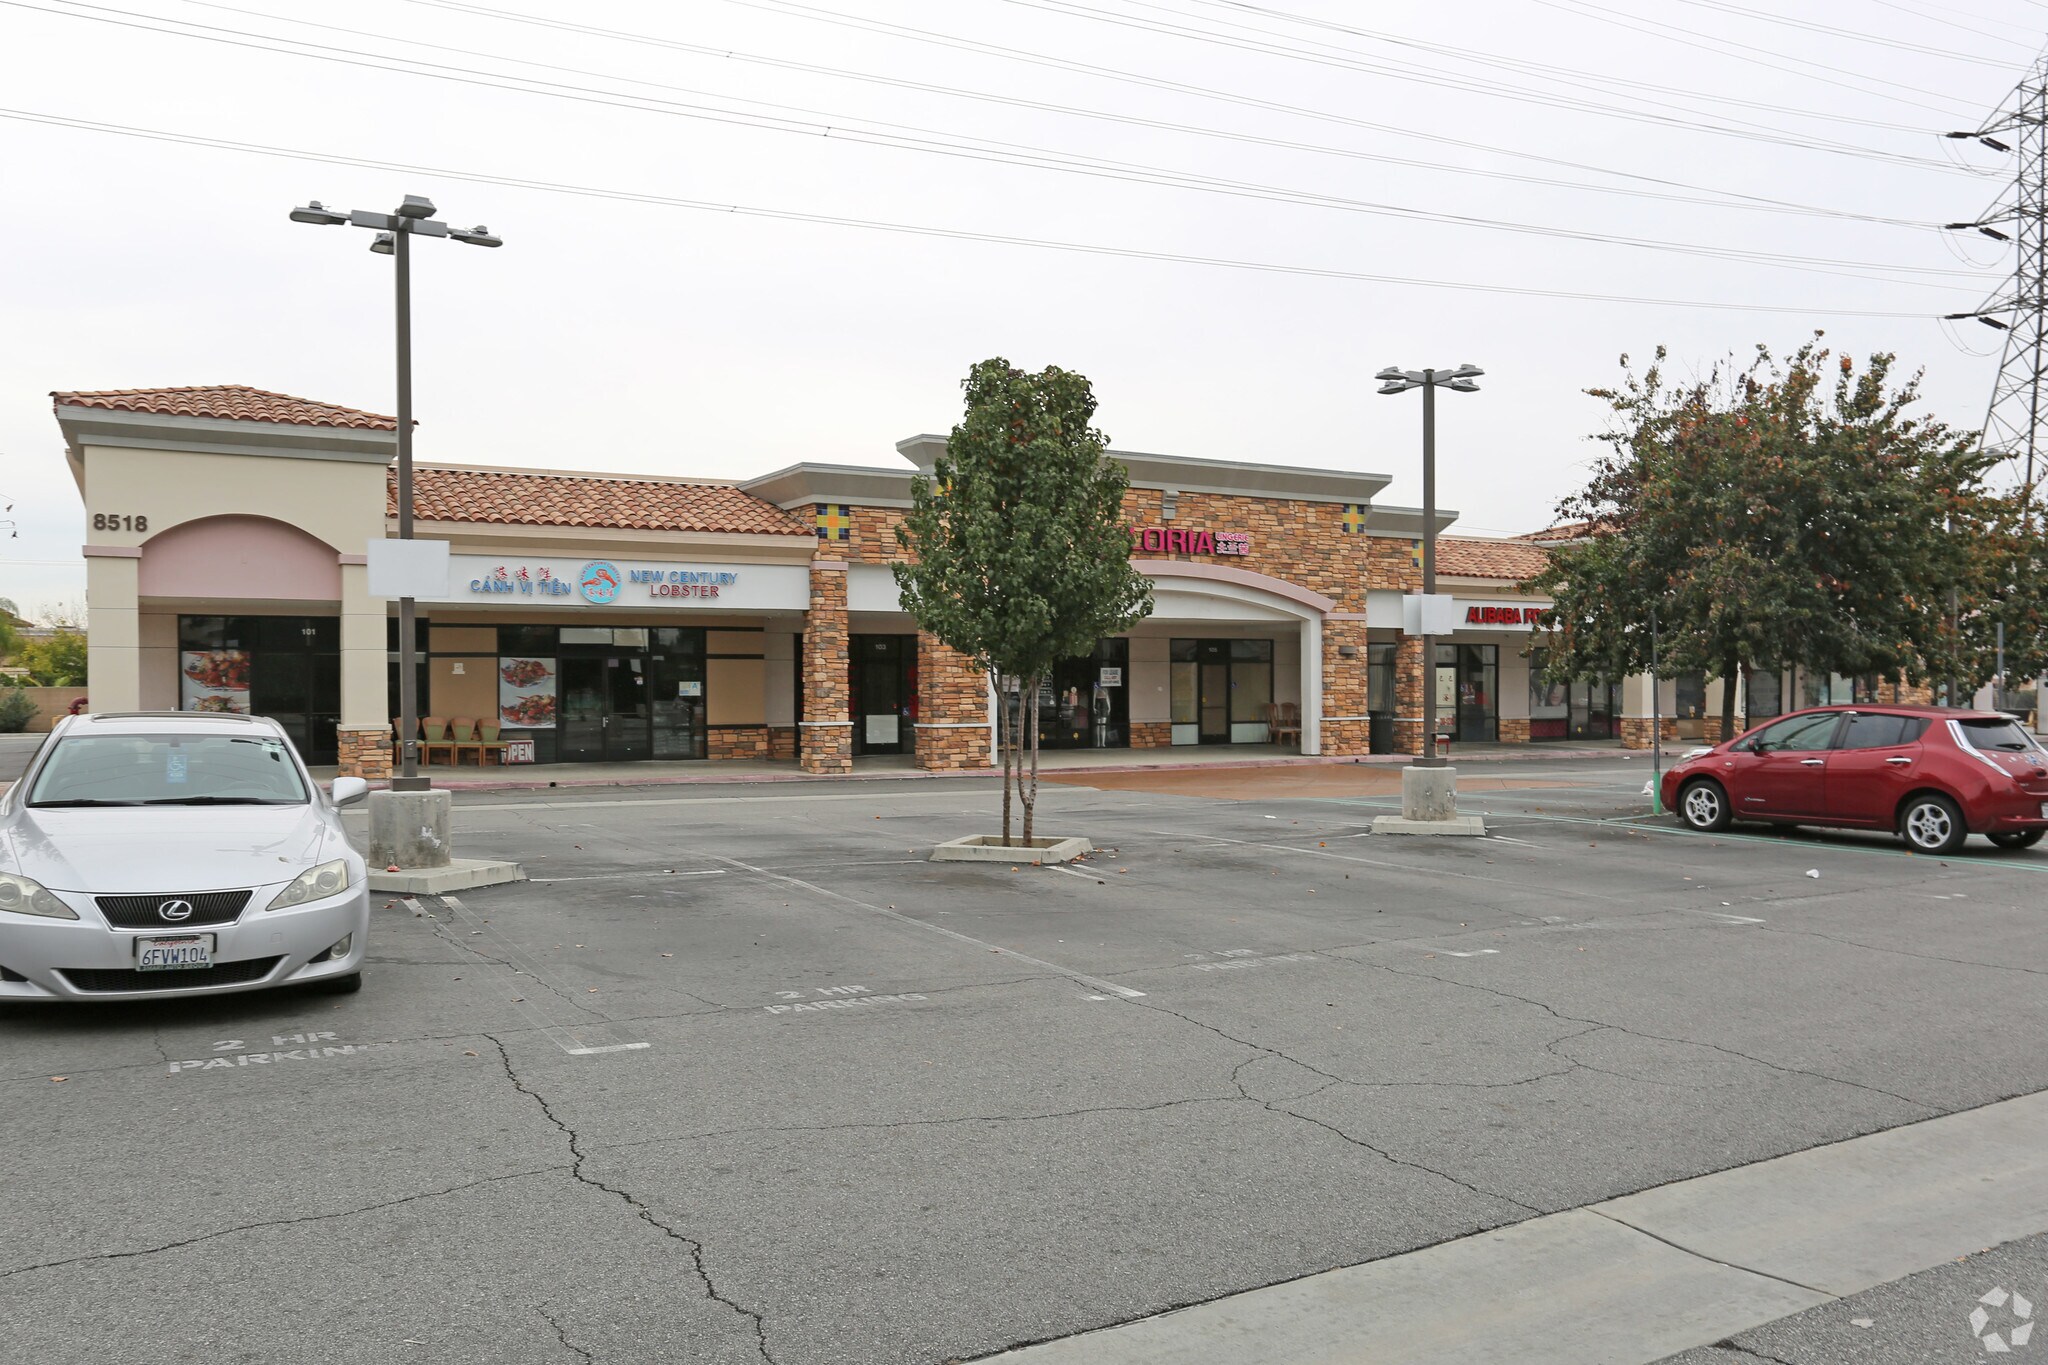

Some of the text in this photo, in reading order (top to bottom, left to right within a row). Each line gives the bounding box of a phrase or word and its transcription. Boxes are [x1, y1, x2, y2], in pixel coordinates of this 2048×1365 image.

[93, 513, 148, 533] 8518
[1215, 531, 1249, 542] LINGERIE
[630, 569, 738, 585] NEW CENTURY
[538, 577, 572, 596] TIÊN
[650, 584, 719, 598] LOBSTER
[1466, 606, 1522, 624] ALIBABA
[142, 947, 207, 965] 6FVW104
[775, 985, 873, 999] 2 HR
[764, 993, 928, 1014] PARKING
[213, 1031, 340, 1051] 2 HR
[169, 1044, 370, 1073] PARKIN
